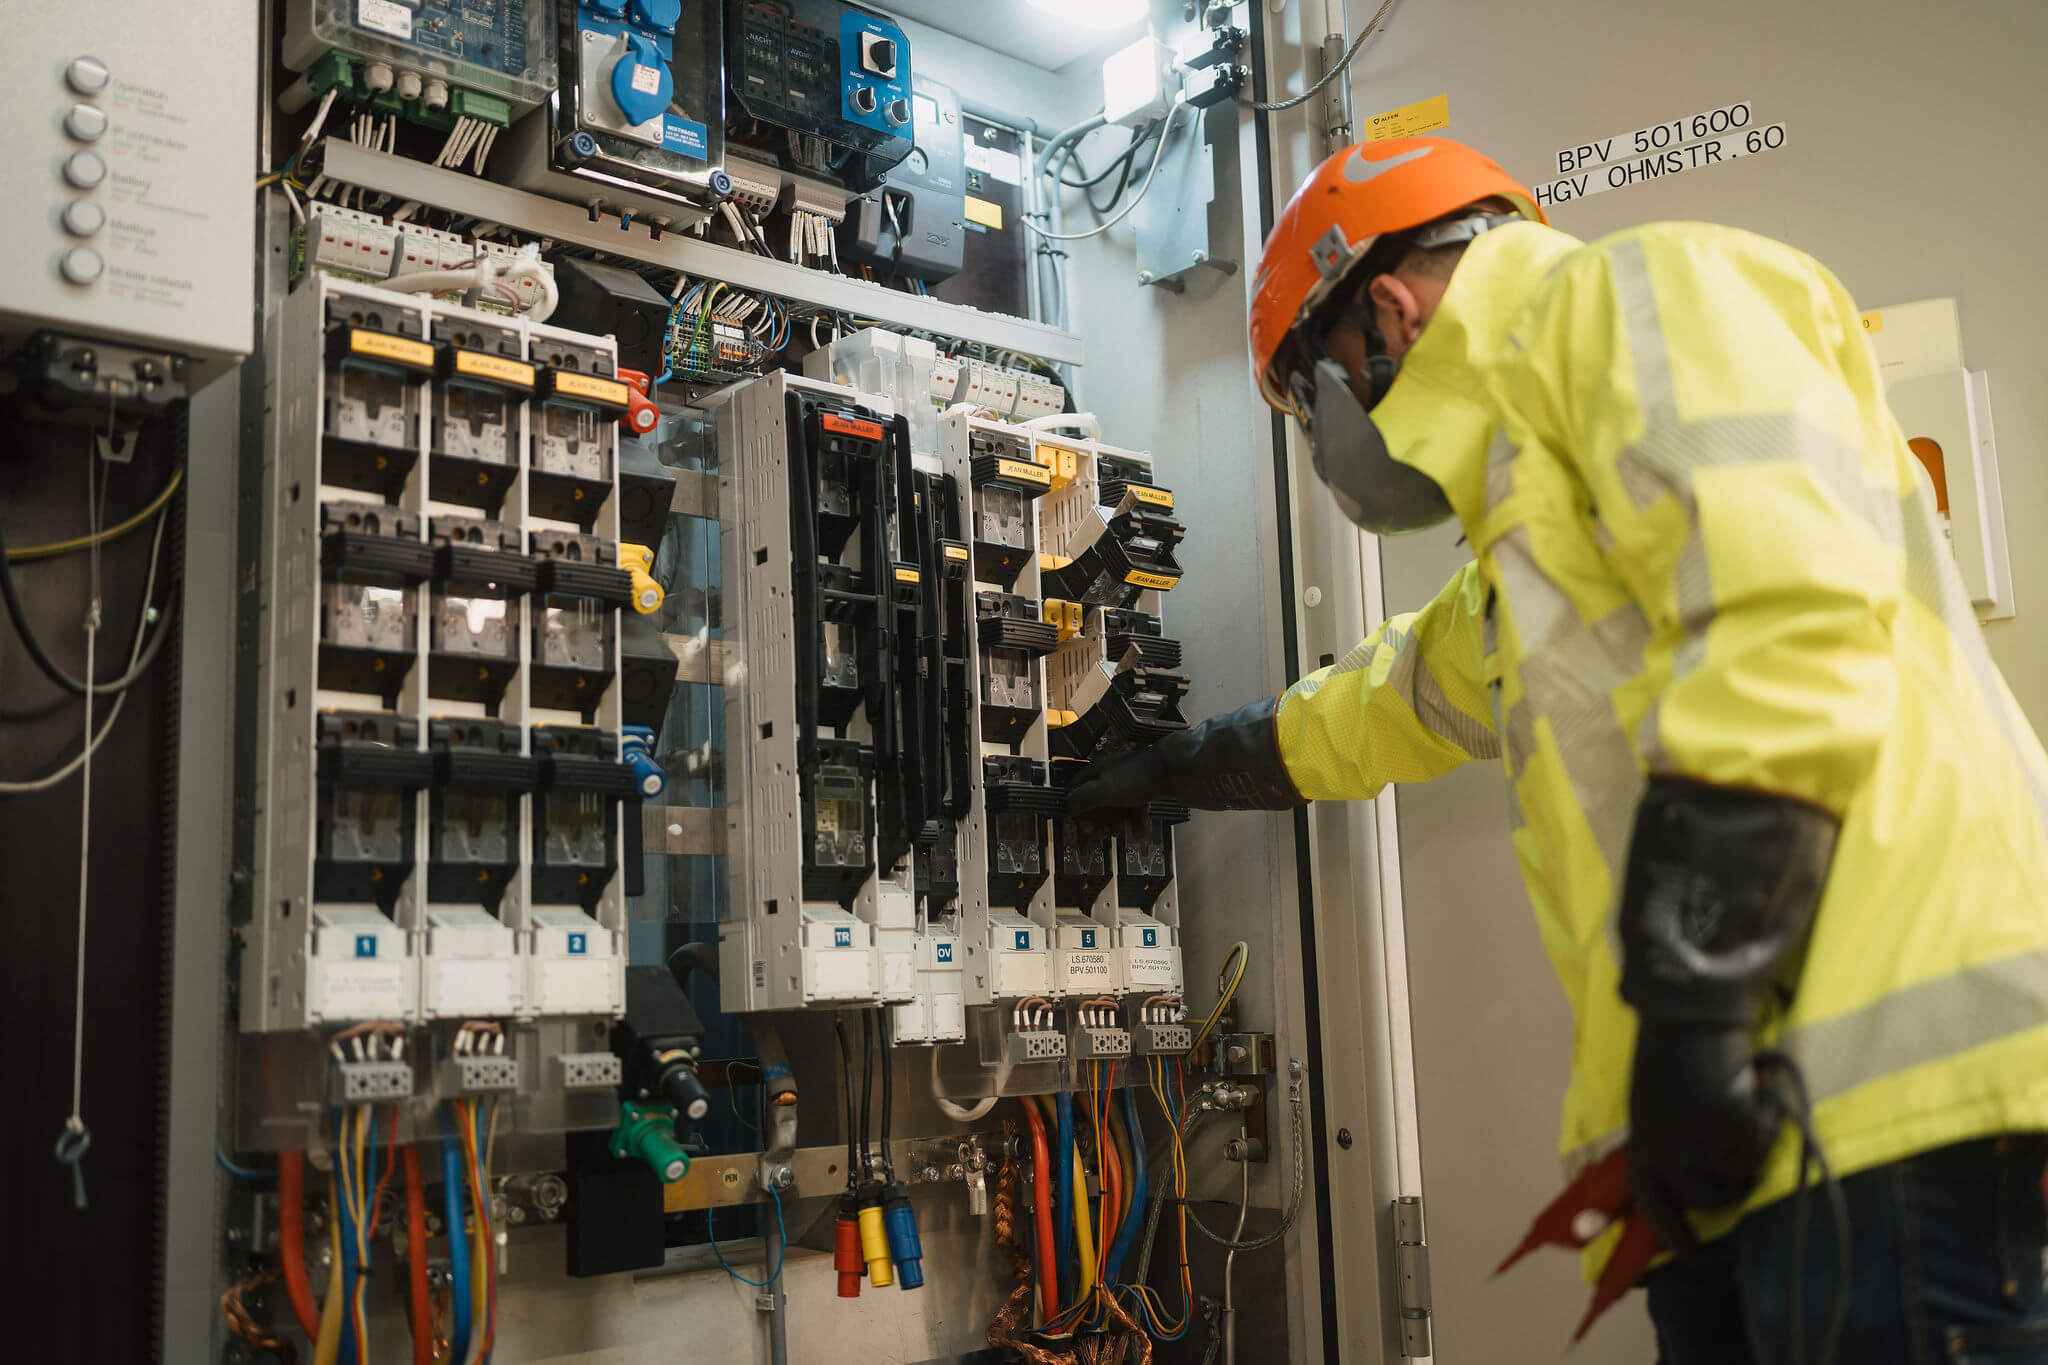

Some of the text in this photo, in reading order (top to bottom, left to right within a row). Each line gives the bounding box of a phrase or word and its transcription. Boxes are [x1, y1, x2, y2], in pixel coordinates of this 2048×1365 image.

[749, 33, 772, 45] NACHT
[1558, 104, 1750, 173] BPV 501600
[1536, 174, 1588, 208] HGV
[836, 931, 850, 943] TR
[1019, 935, 1025, 945] 4
[1086, 934, 1092, 944] 5
[1146, 932, 1153, 942] 6
[725, 1173, 738, 1183] PEN
